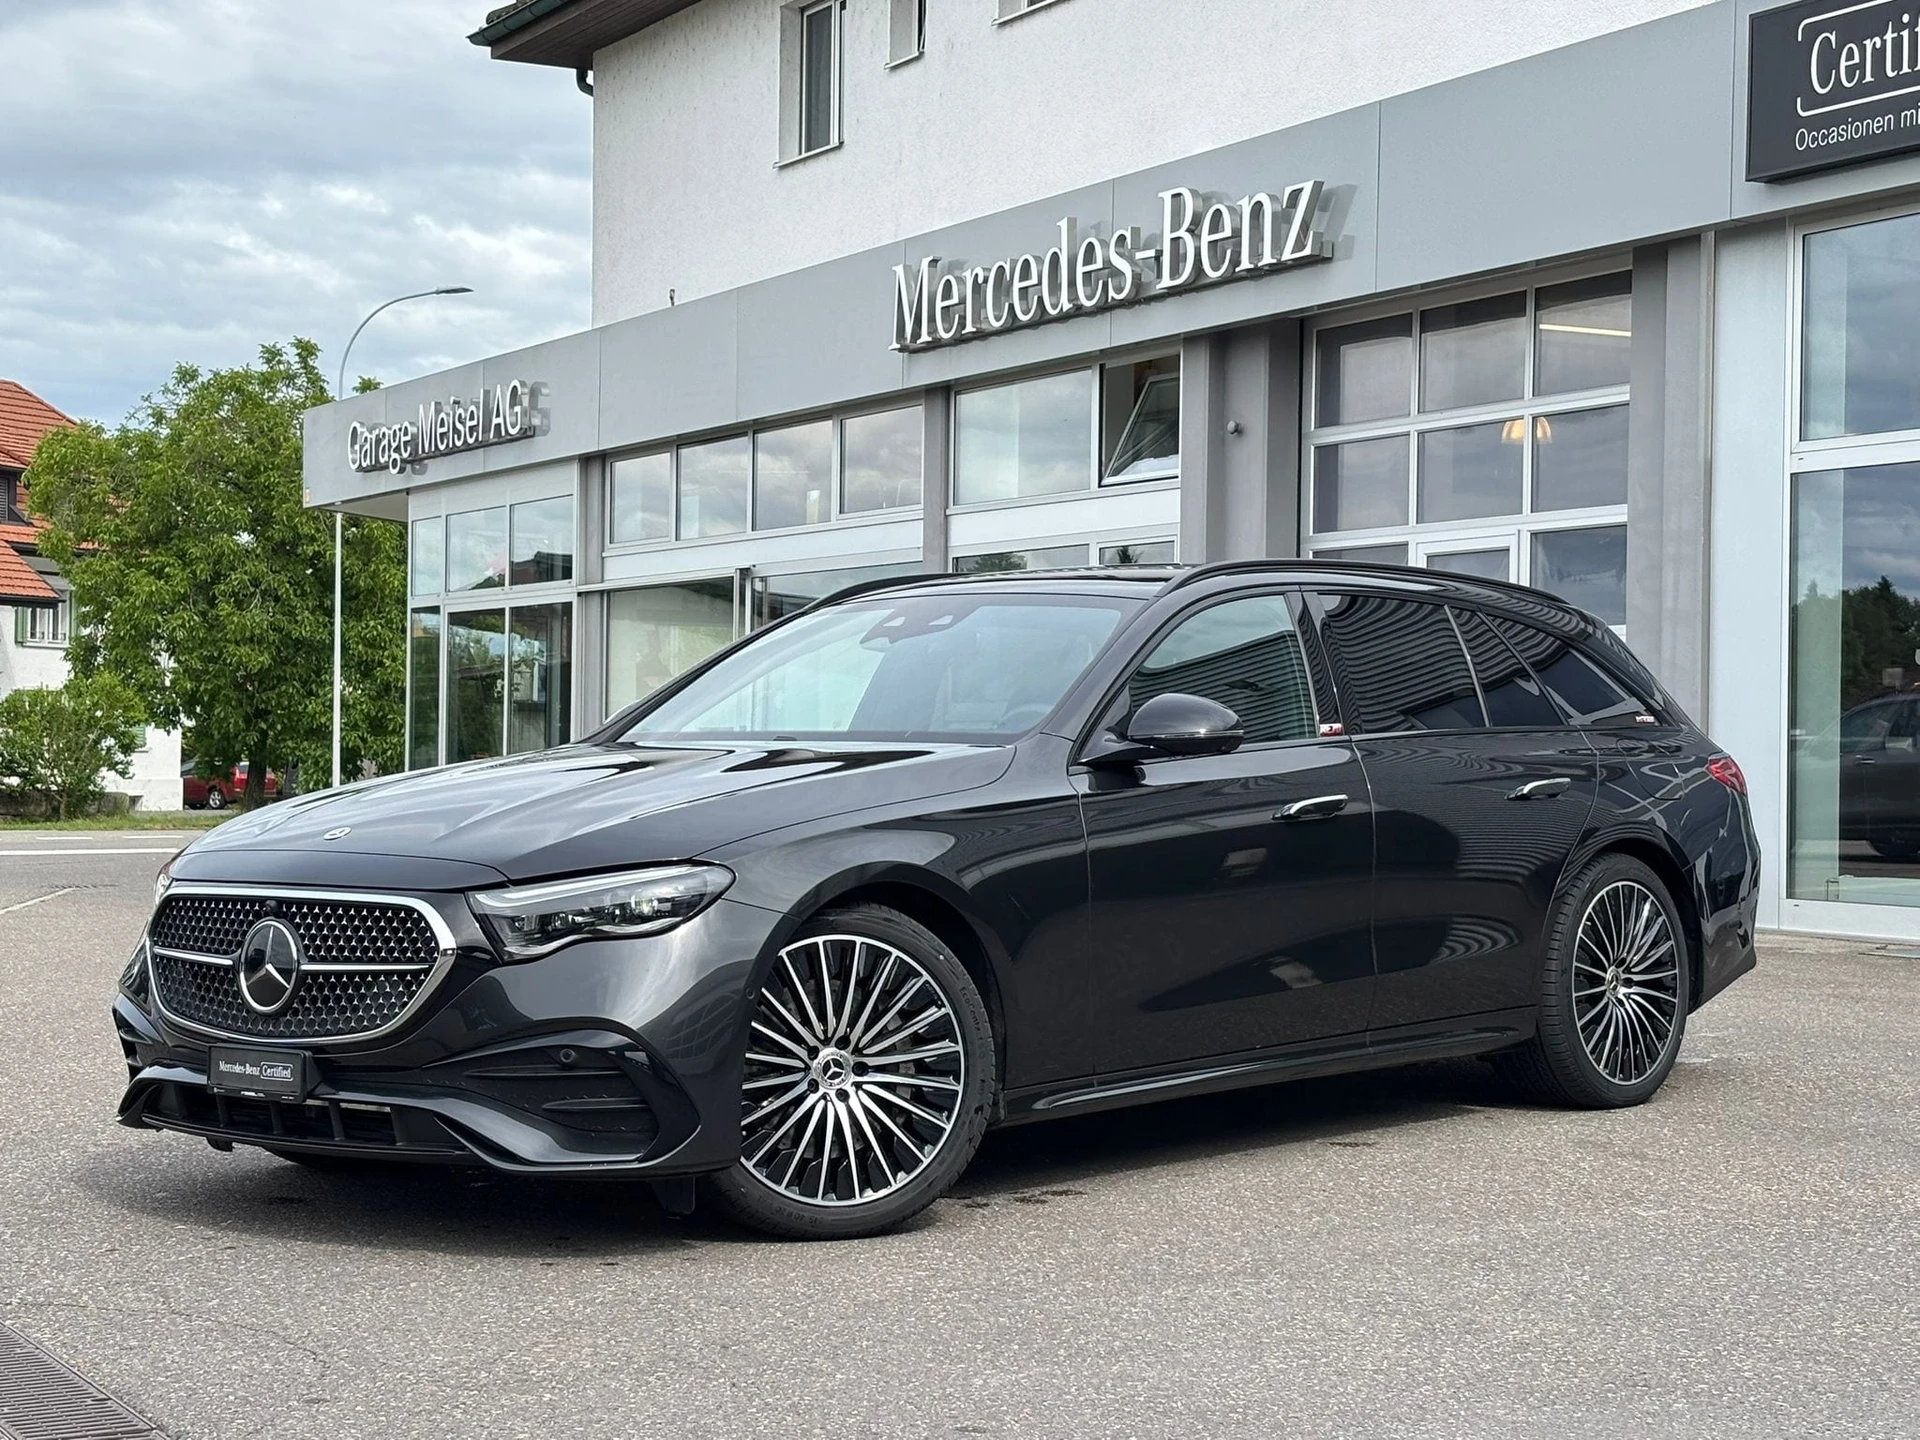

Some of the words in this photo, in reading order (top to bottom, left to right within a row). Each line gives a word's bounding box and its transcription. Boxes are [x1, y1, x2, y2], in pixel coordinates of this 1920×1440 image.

[1795, 113, 1894, 151] Occasionen
[888, 179, 1325, 351] Mercedes-Benz
[347, 420, 411, 474] Garage
[418, 388, 485, 454] Meisel
[490, 379, 523, 439] AG
[219, 1060, 260, 1076] Mercedes-Benz
[262, 1065, 291, 1078] Certified
